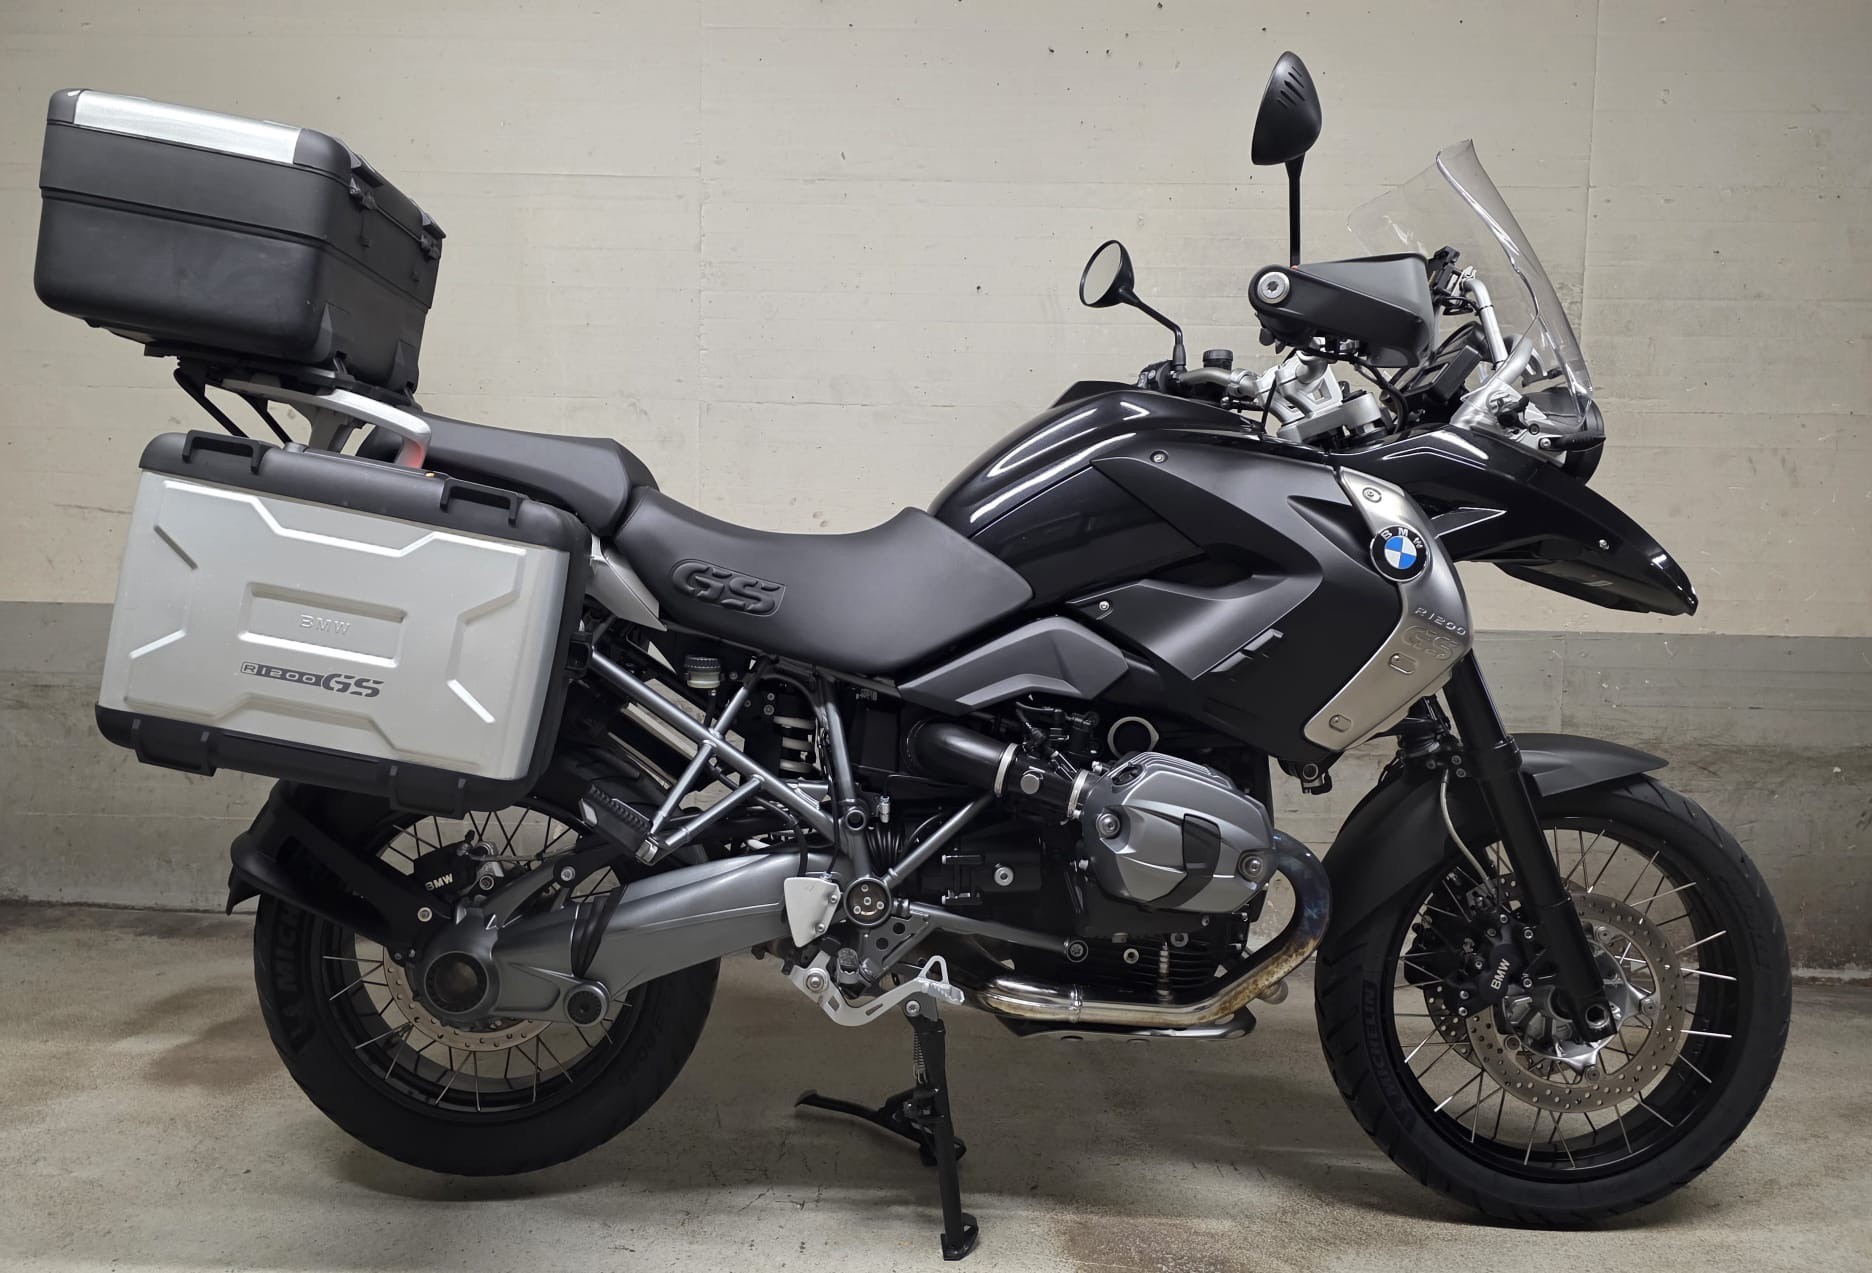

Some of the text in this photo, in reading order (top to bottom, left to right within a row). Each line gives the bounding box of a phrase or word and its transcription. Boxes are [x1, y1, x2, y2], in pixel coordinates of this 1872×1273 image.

[1380, 527, 1424, 549] BMW
[672, 562, 781, 614] GS
[299, 614, 351, 636] BMW
[1413, 607, 1467, 636] R1200
[1401, 624, 1458, 661] GS
[321, 673, 385, 698] GS
[425, 873, 453, 891] BMW
[274, 901, 301, 992] MICH
[1490, 958, 1511, 990] BMW
[1362, 982, 1401, 1097] MICHELIN
